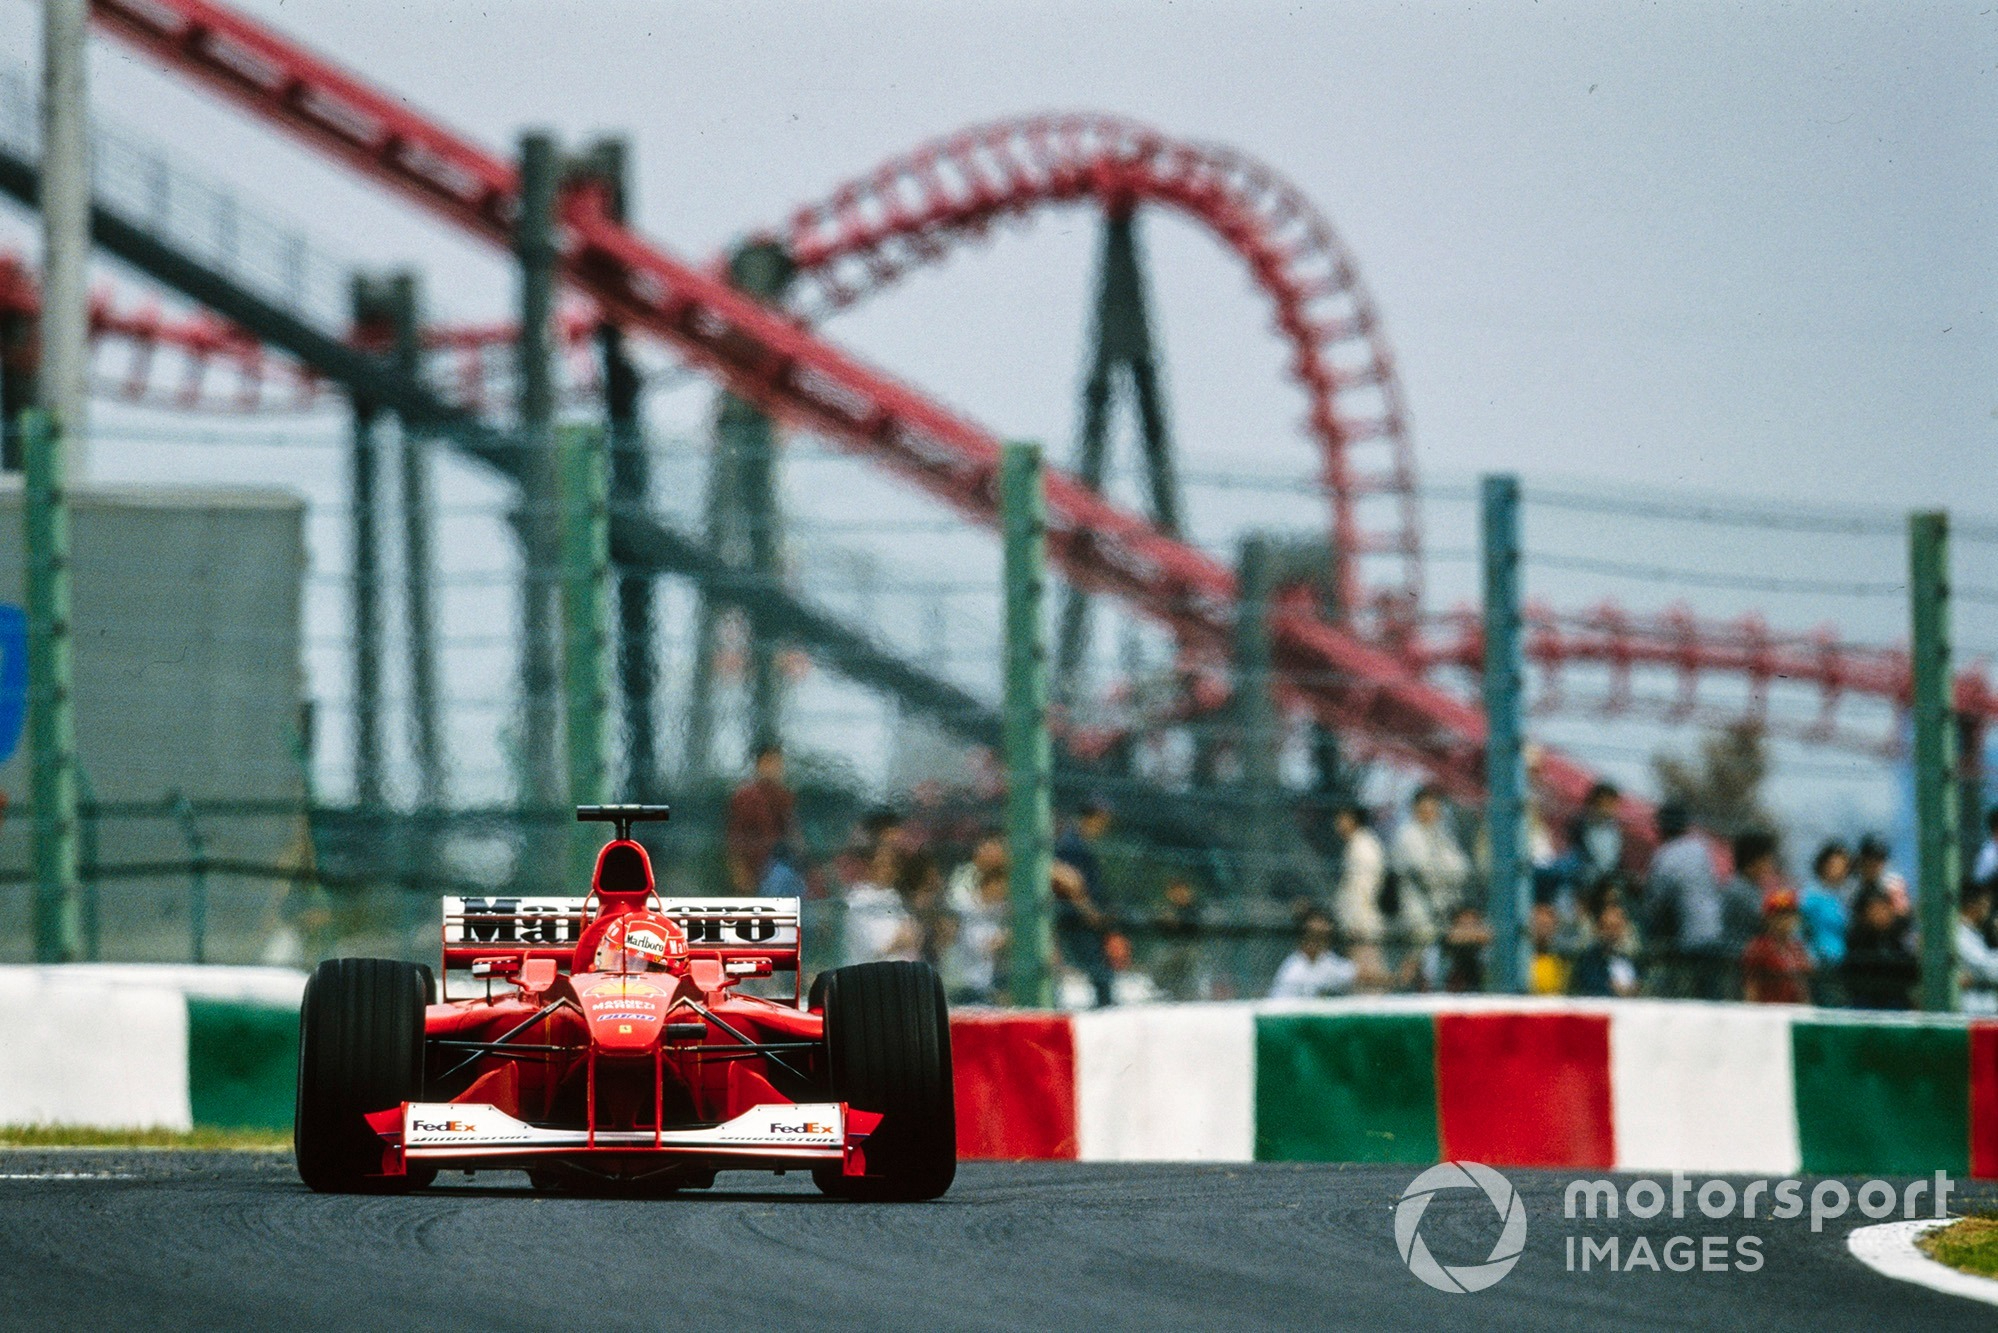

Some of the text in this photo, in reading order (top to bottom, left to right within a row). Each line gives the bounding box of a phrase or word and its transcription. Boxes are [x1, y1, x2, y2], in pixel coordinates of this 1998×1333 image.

[460, 898, 777, 943] Maroro
[626, 934, 664, 953] Marlboro
[413, 1120, 477, 1132] FedEx
[770, 1122, 834, 1134] FedEx
